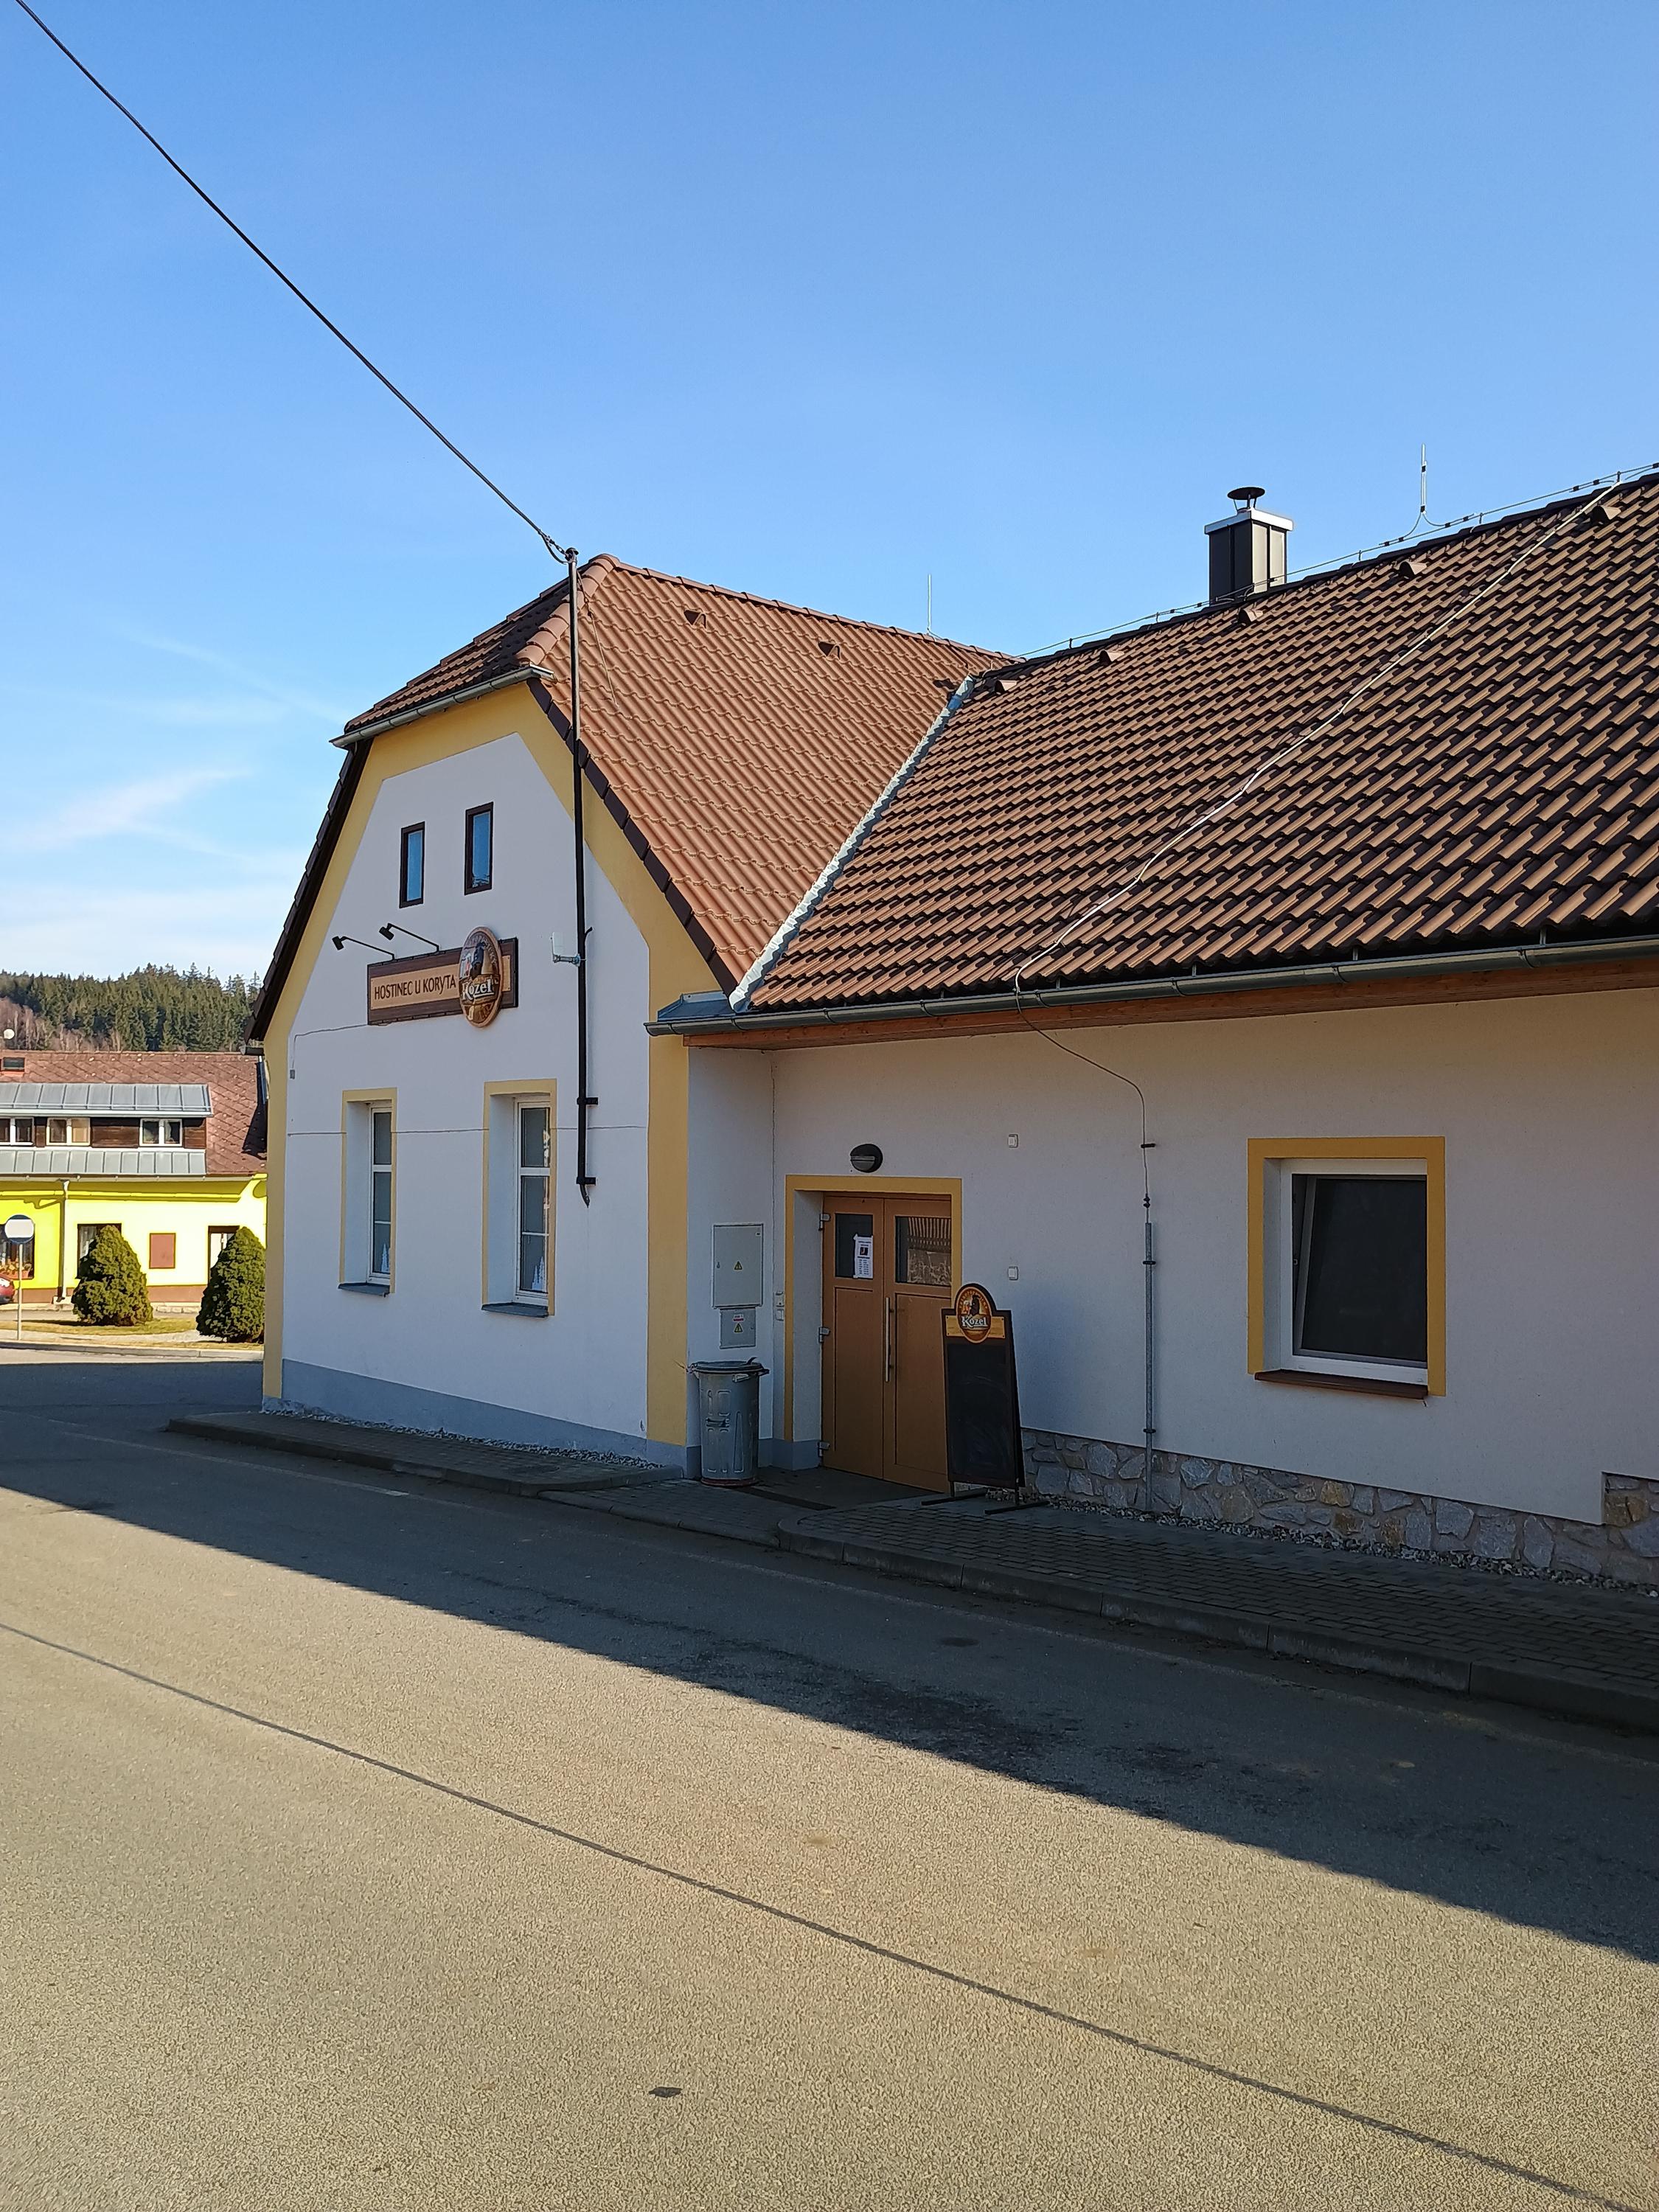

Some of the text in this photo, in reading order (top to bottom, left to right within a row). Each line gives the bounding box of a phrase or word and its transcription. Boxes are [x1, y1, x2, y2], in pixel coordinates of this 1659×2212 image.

[375, 974, 456, 1000] HOSTINEC U KORYTA
[462, 979, 493, 1001] Kozel
[961, 1314, 987, 1328] Kozel
